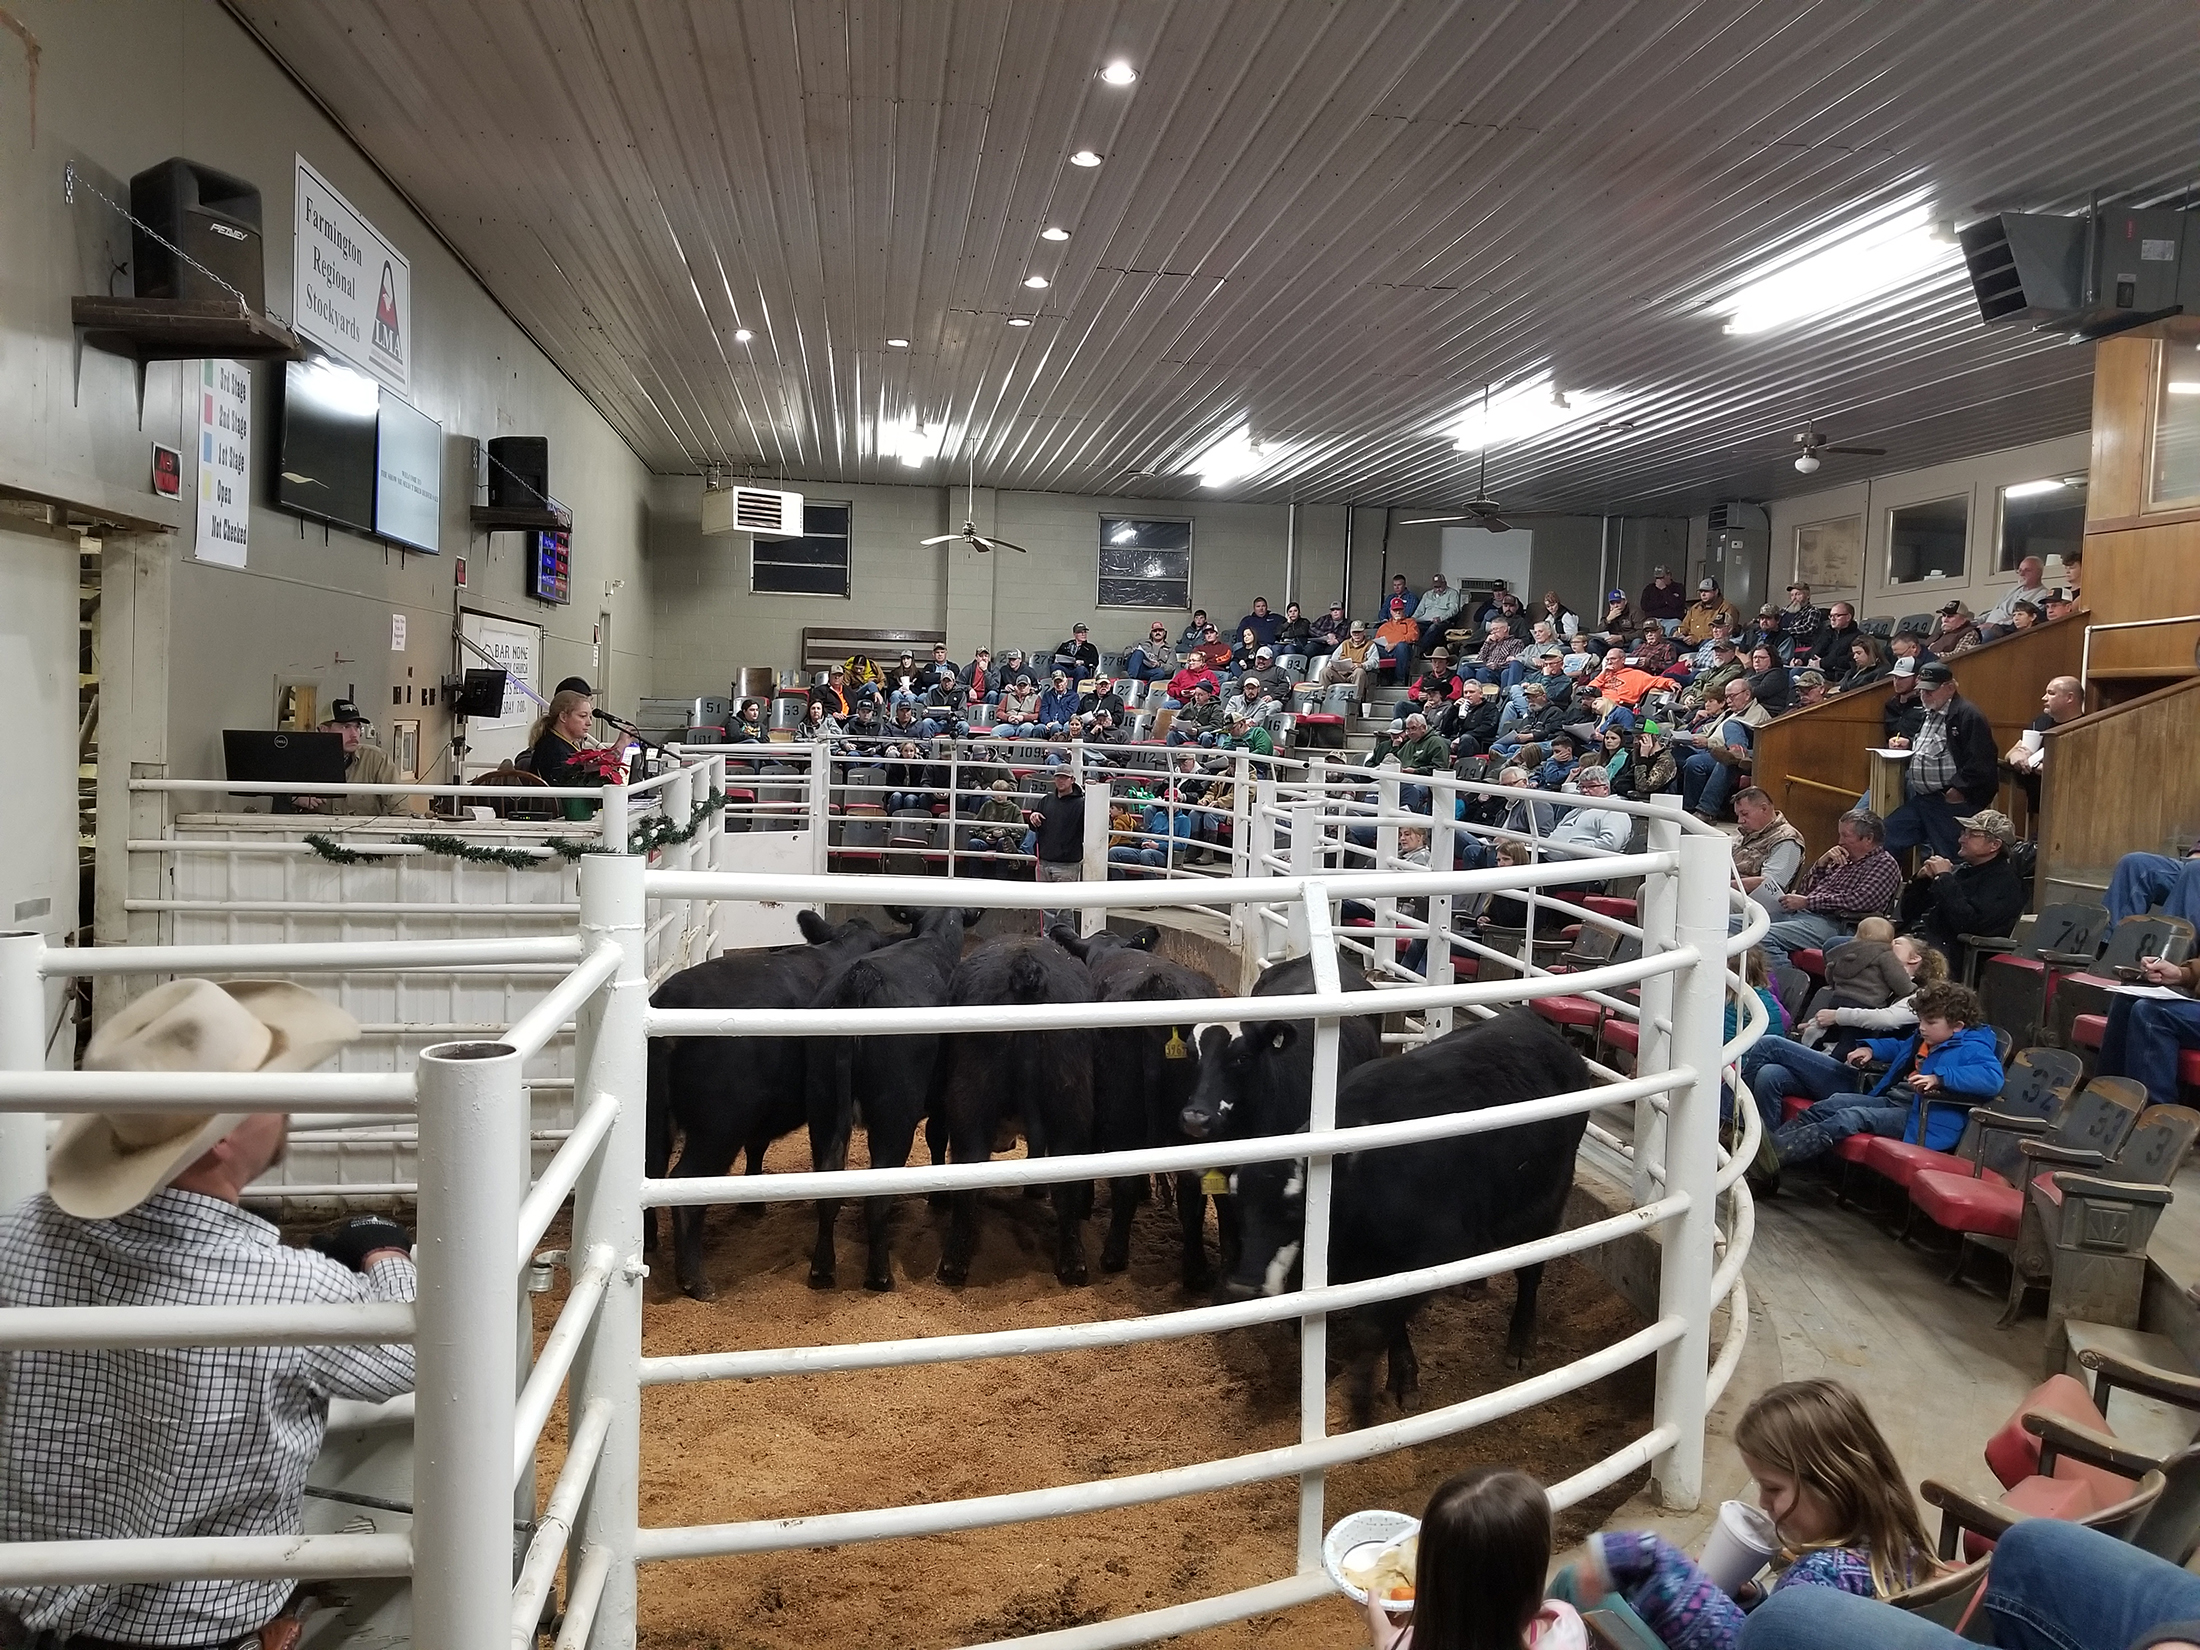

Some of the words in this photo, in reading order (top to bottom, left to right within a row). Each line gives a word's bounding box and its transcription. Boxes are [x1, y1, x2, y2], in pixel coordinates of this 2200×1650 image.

[210, 223, 248, 240] PEAVEY
[305, 195, 362, 266] Farmington
[312, 245, 356, 300] Regional
[306, 283, 360, 343] Stockyards
[375, 318, 404, 359] LMA
[219, 367, 230, 393] 3rd
[231, 373, 246, 404] Stage
[218, 405, 230, 429] 2nd
[231, 409, 247, 440] Stage
[218, 442, 228, 468] 1st
[229, 446, 245, 476] Stage
[216, 479, 232, 507] Open
[211, 514, 222, 539] Not
[223, 518, 247, 545] Checked
[495, 644, 510, 659] BAR
[512, 645, 528, 660] NONE
[1137, 751, 1156, 763] 112
[2054, 920, 2089, 954] 79
